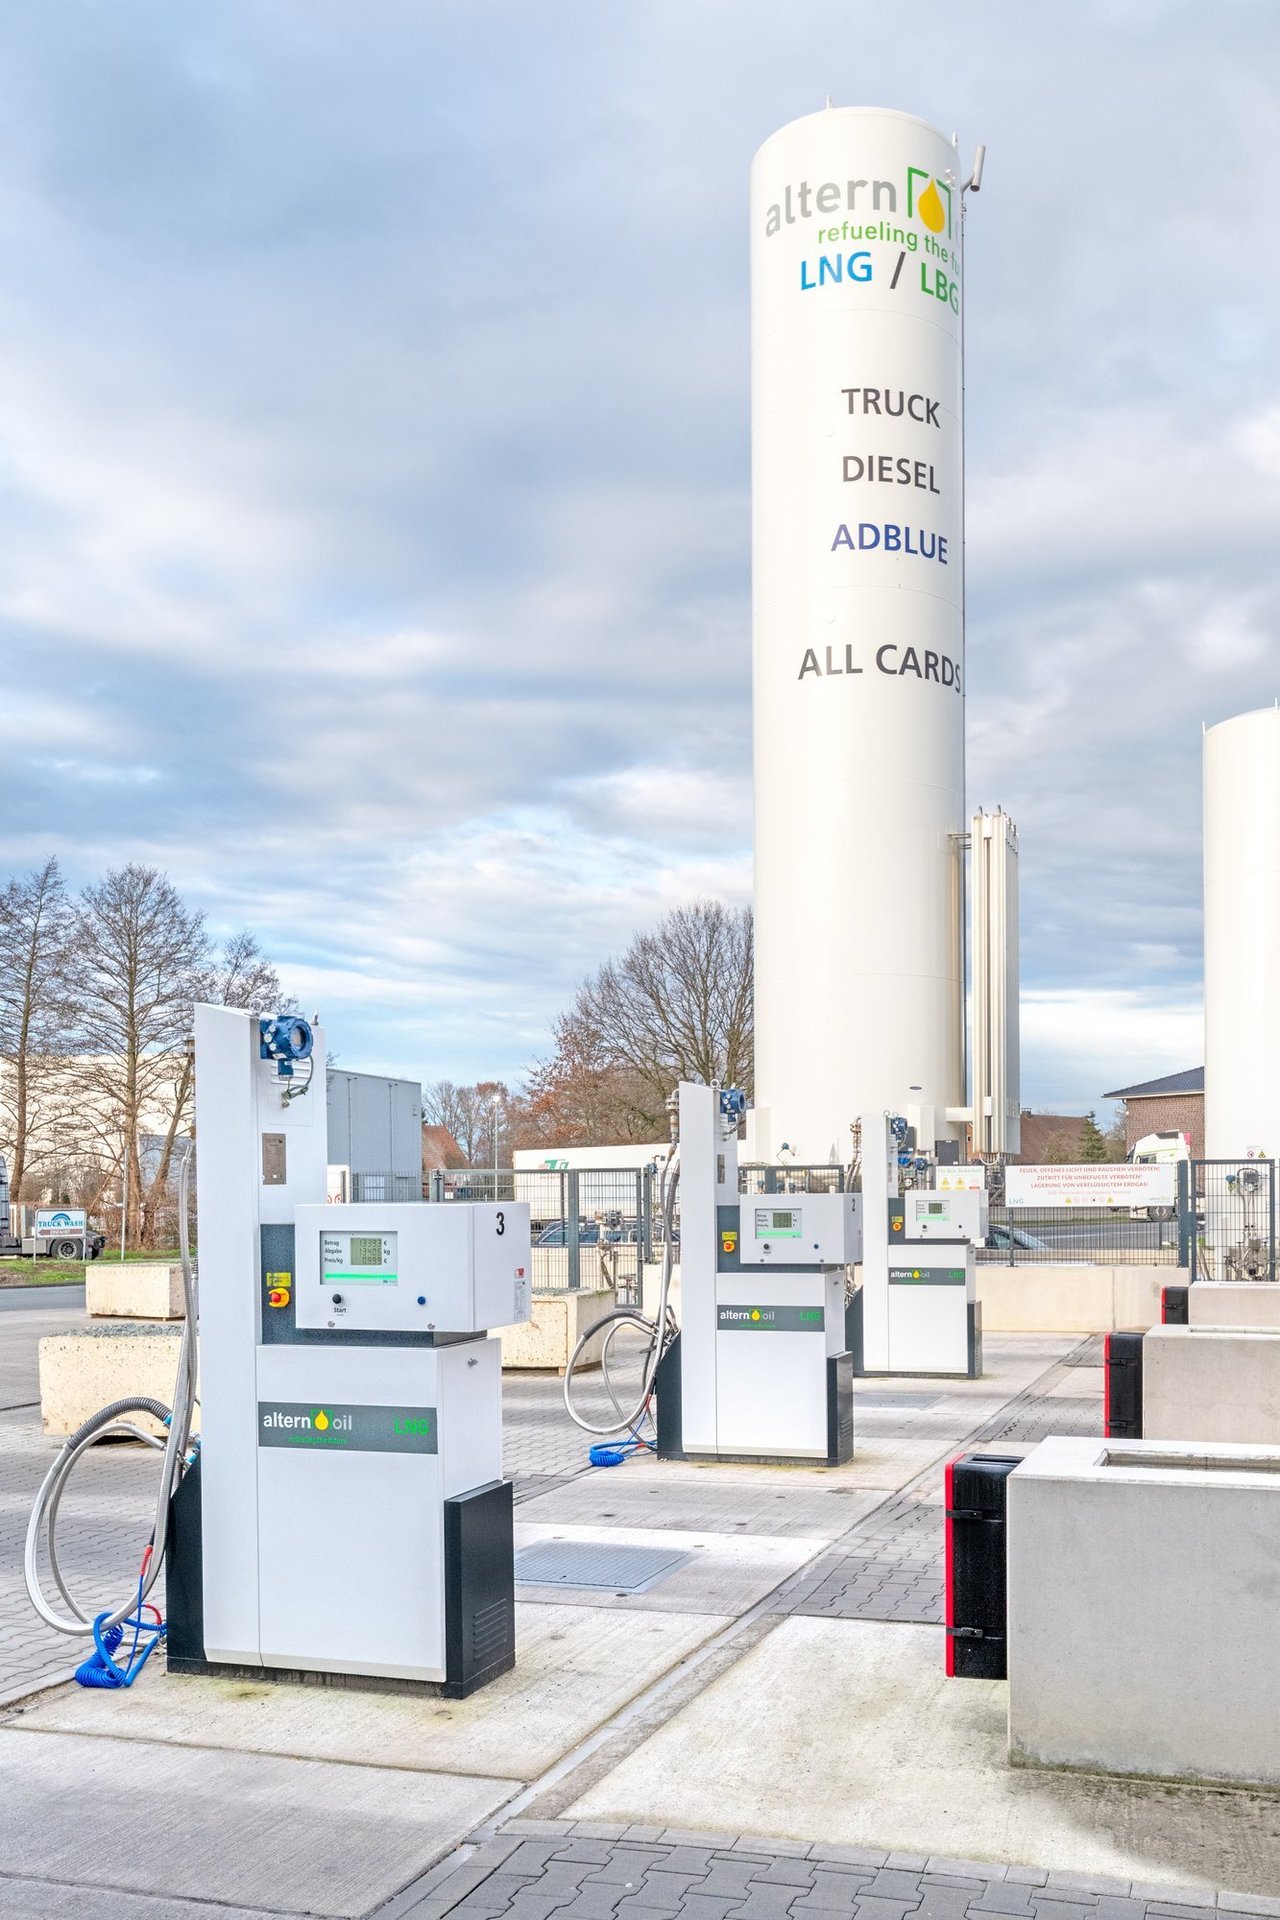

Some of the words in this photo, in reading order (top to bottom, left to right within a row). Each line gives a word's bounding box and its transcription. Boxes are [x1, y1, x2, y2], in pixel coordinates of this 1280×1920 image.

[765, 179, 897, 238] altern
[818, 221, 918, 252] refueling
[924, 235, 948, 263] the
[801, 251, 873, 291] LNG
[890, 251, 906, 290] /
[921, 262, 960, 316] LBG
[841, 388, 941, 429] TRUCK
[842, 455, 940, 495] DIESEL
[830, 523, 948, 565] ADBLUE
[798, 644, 863, 681] ALL
[875, 644, 961, 694] CARDS
[496, 1212, 505, 1236] 3
[720, 1310, 750, 1320] altern
[762, 1311, 775, 1320] oil
[800, 1311, 821, 1321] LNG
[263, 1412, 311, 1429] altern
[332, 1415, 353, 1430] oil
[393, 1418, 429, 1436] LNG
